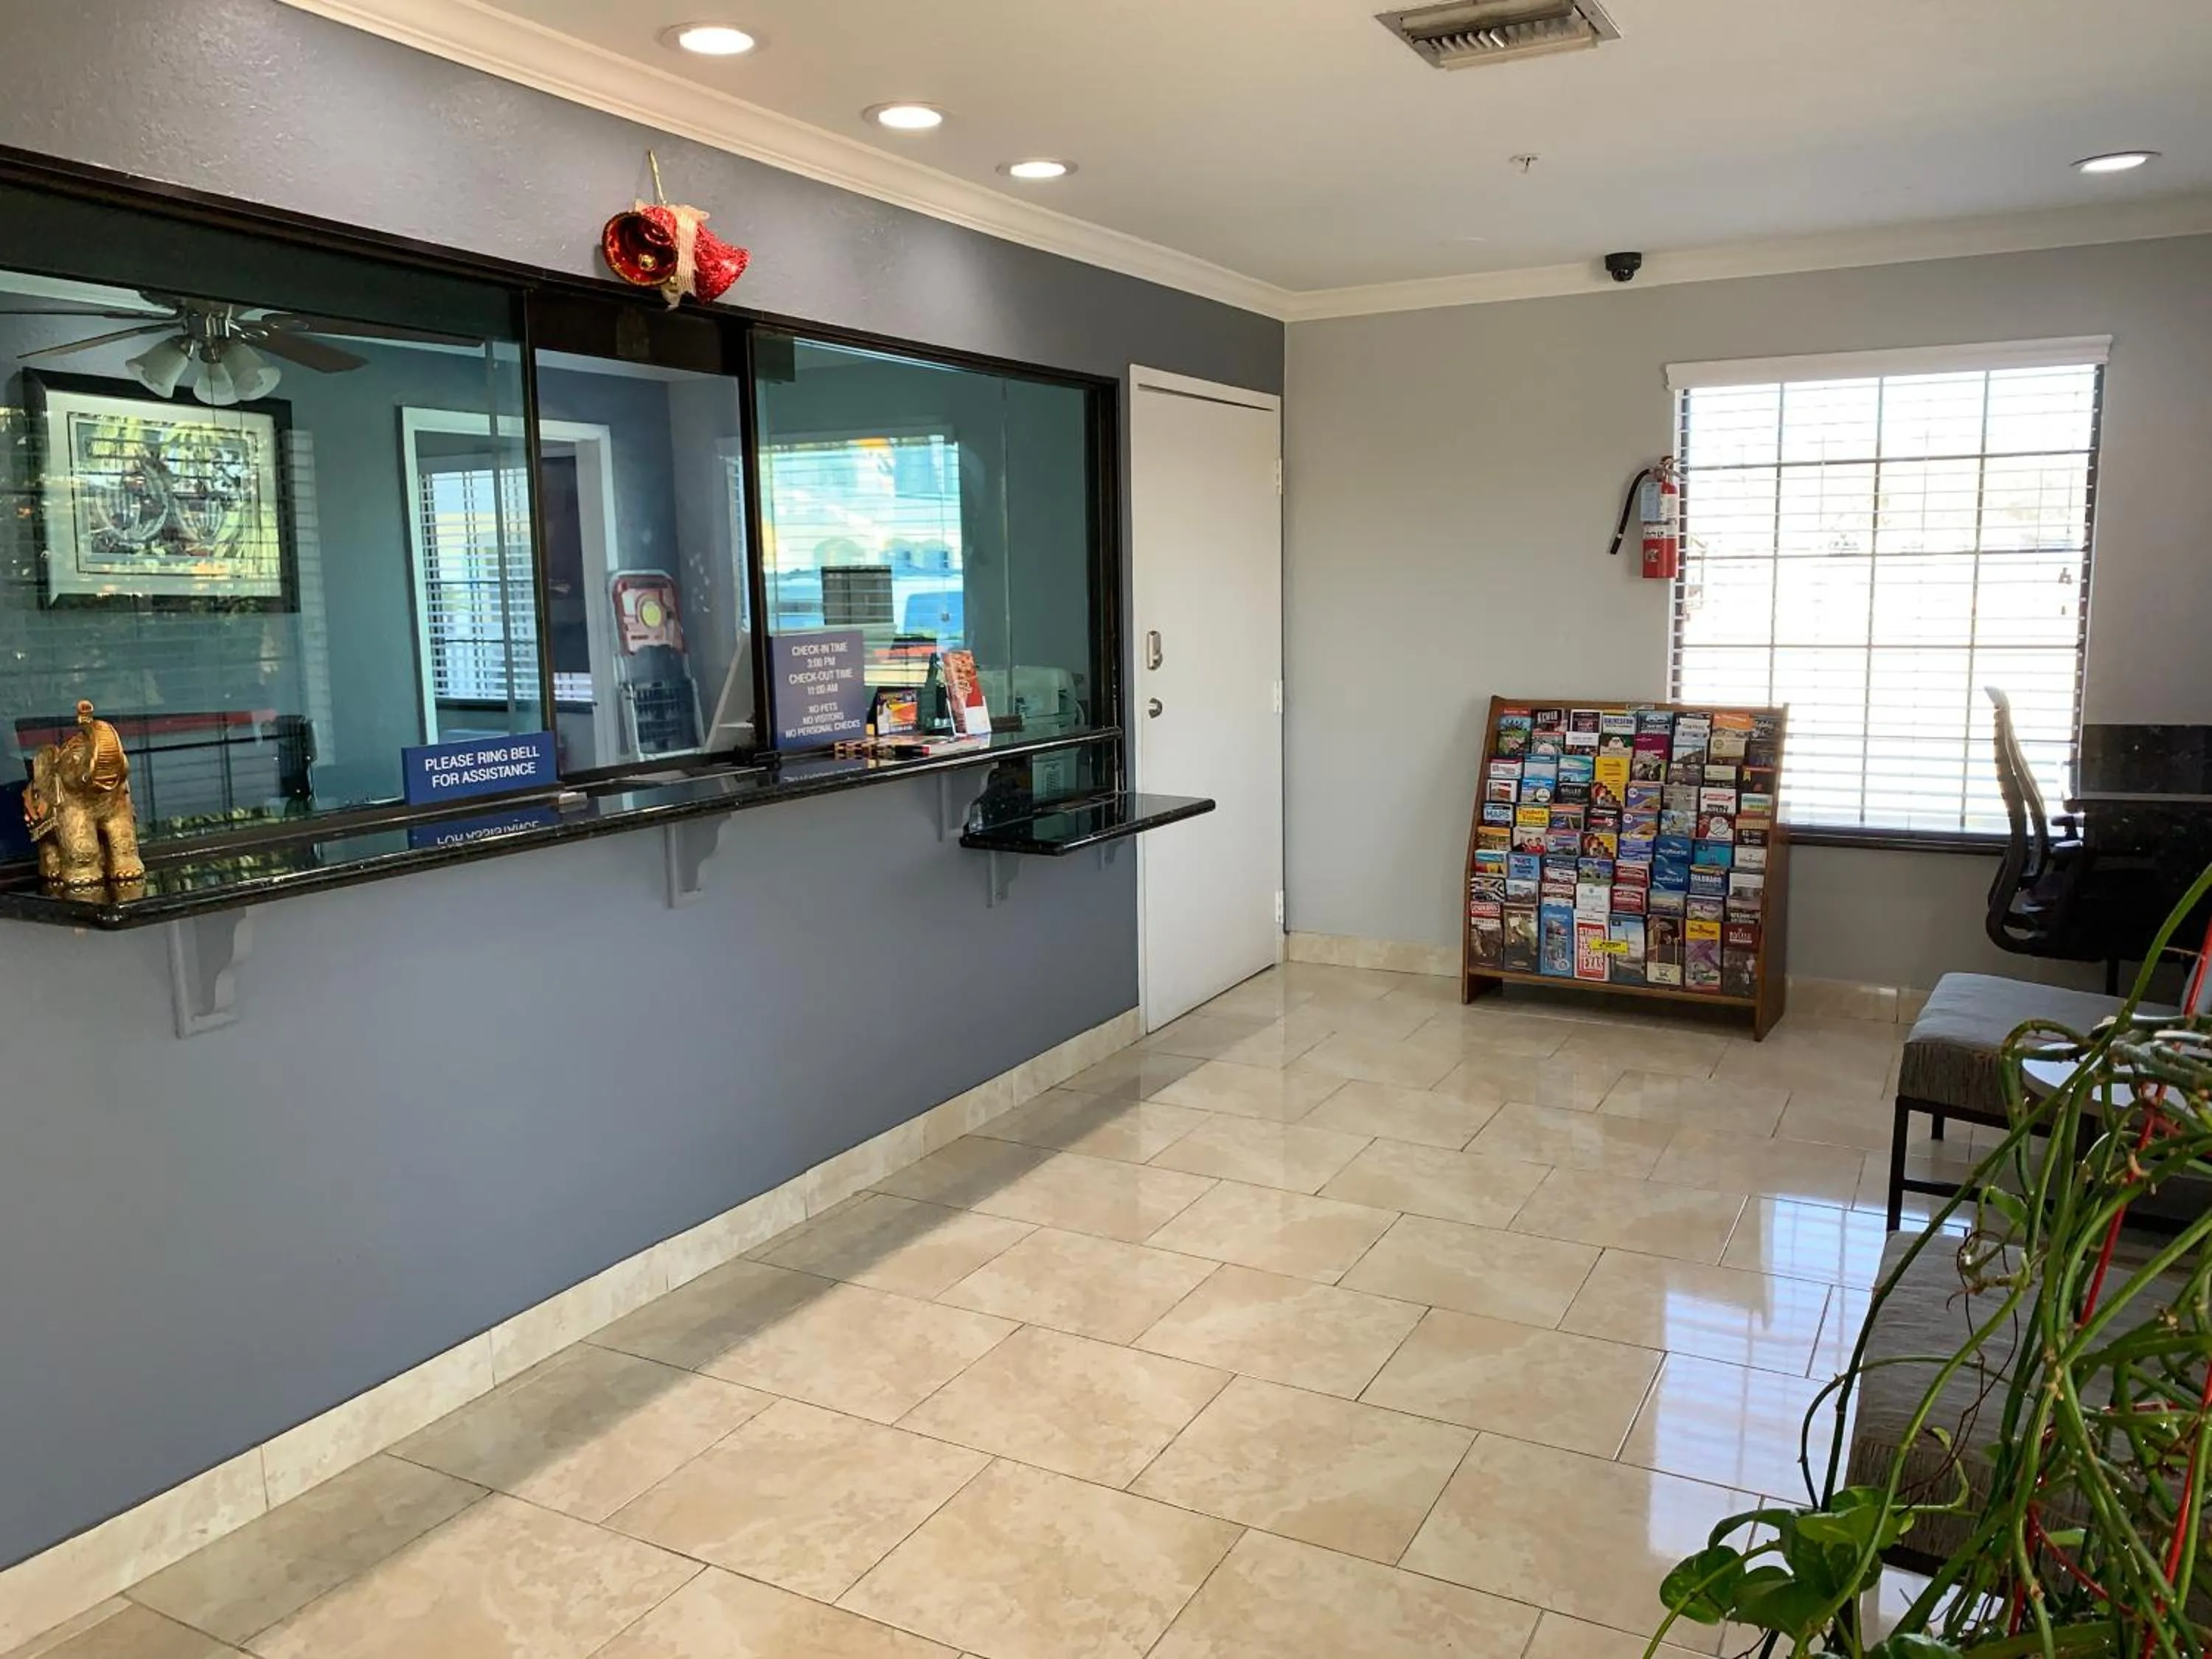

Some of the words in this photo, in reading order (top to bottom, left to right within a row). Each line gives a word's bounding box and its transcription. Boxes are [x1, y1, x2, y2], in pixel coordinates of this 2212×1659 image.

[791, 644, 830, 656] CHECK-IN
[831, 641, 848, 653] TIME
[824, 656, 835, 666] PM
[788, 670, 834, 684] CHECK-OUT
[836, 667, 853, 679] TIME
[807, 684, 825, 695] 11:00
[827, 683, 838, 692] AM
[810, 704, 819, 713] NO
[821, 702, 838, 712] PETS
[803, 716, 813, 724] NO
[815, 712, 844, 723] VISITORS
[785, 728, 796, 738] NO
[797, 724, 833, 736] PERSONAL
[834, 720, 860, 731] CHECKS
[425, 753, 474, 771] PLEASE
[477, 748, 508, 764] RING
[510, 745, 540, 760] BELL
[432, 773, 459, 788] FOR
[462, 762, 536, 784] ASSISTANCE
